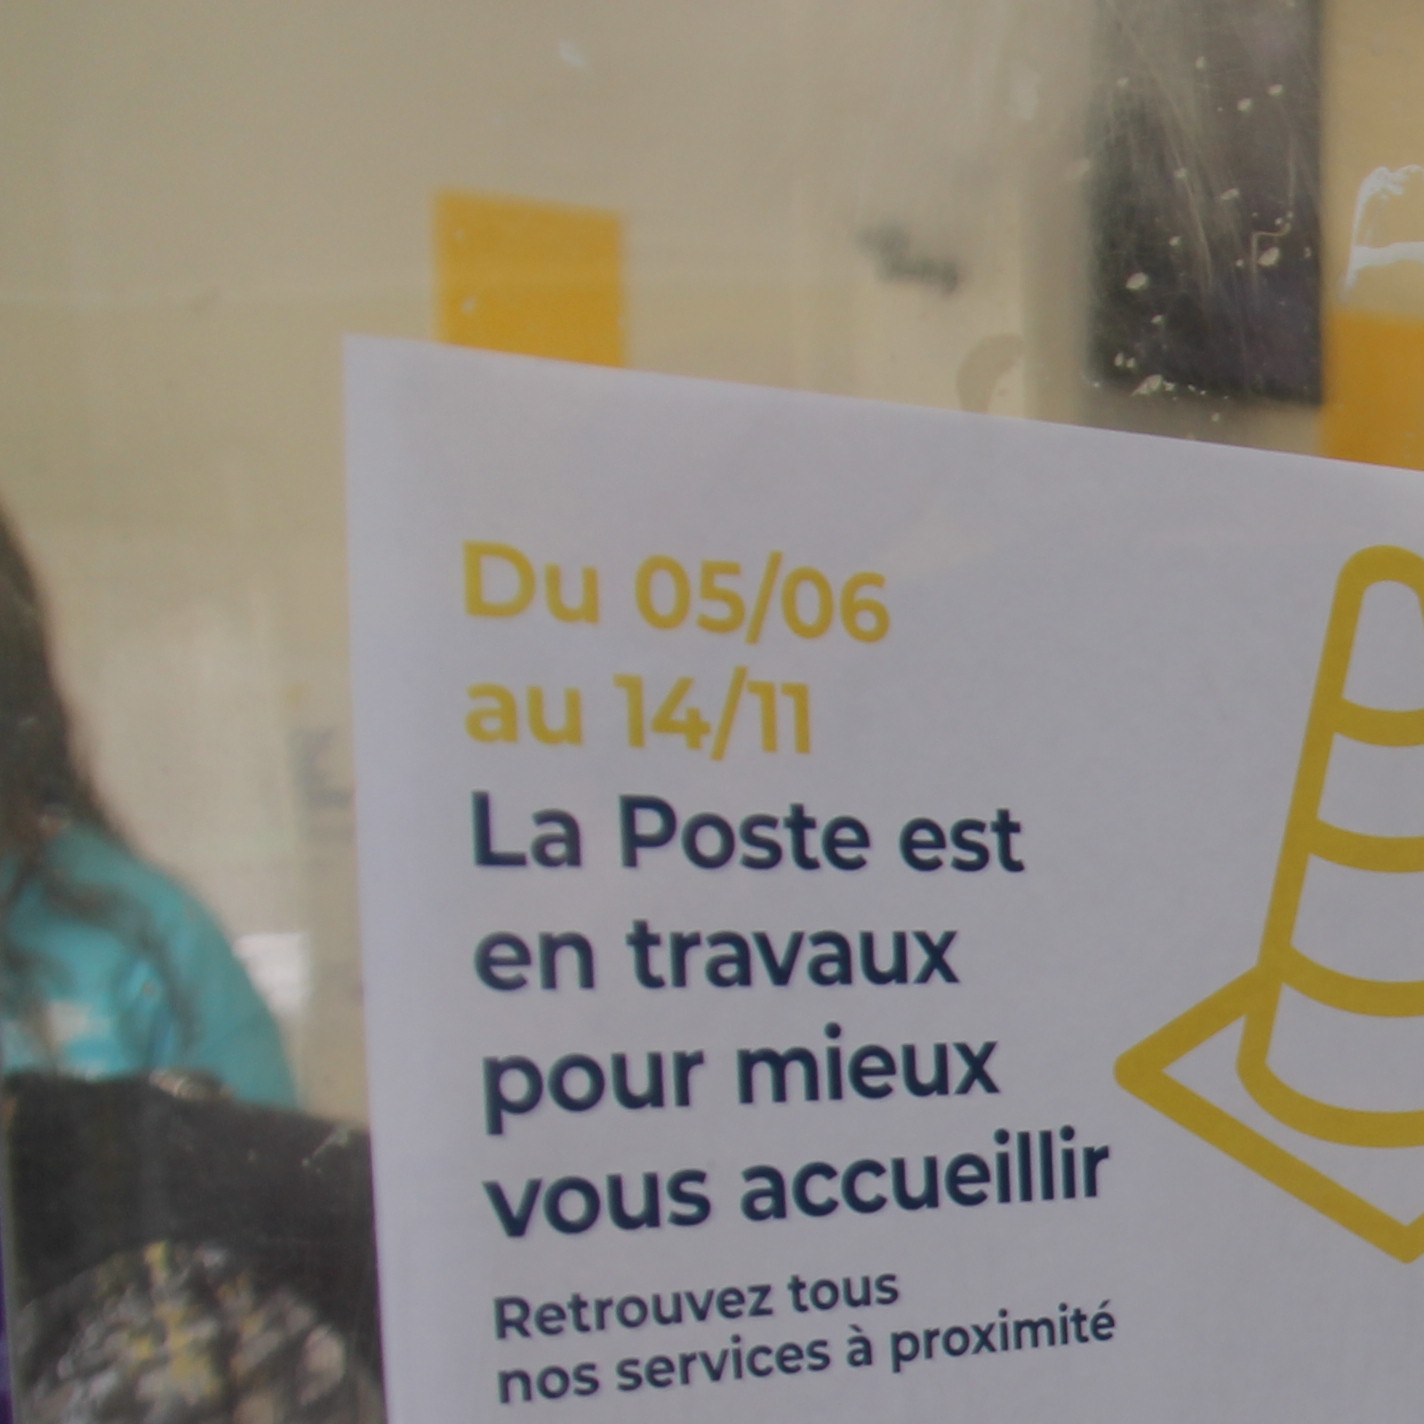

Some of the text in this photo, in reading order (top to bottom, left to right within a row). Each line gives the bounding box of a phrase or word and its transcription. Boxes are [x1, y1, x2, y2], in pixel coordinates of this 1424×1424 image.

[463, 540, 891, 645] Du 05/06
[465, 665, 811, 761] au 14/11
[472, 791, 1026, 873] La Poste est
[474, 920, 960, 992] en travaux
[484, 1022, 1000, 1136] pour mieux
[484, 1125, 1110, 1239] vous accueillir
[494, 1273, 900, 1345] Retrouvez tous
[498, 1299, 1116, 1405] nos services à proximité
